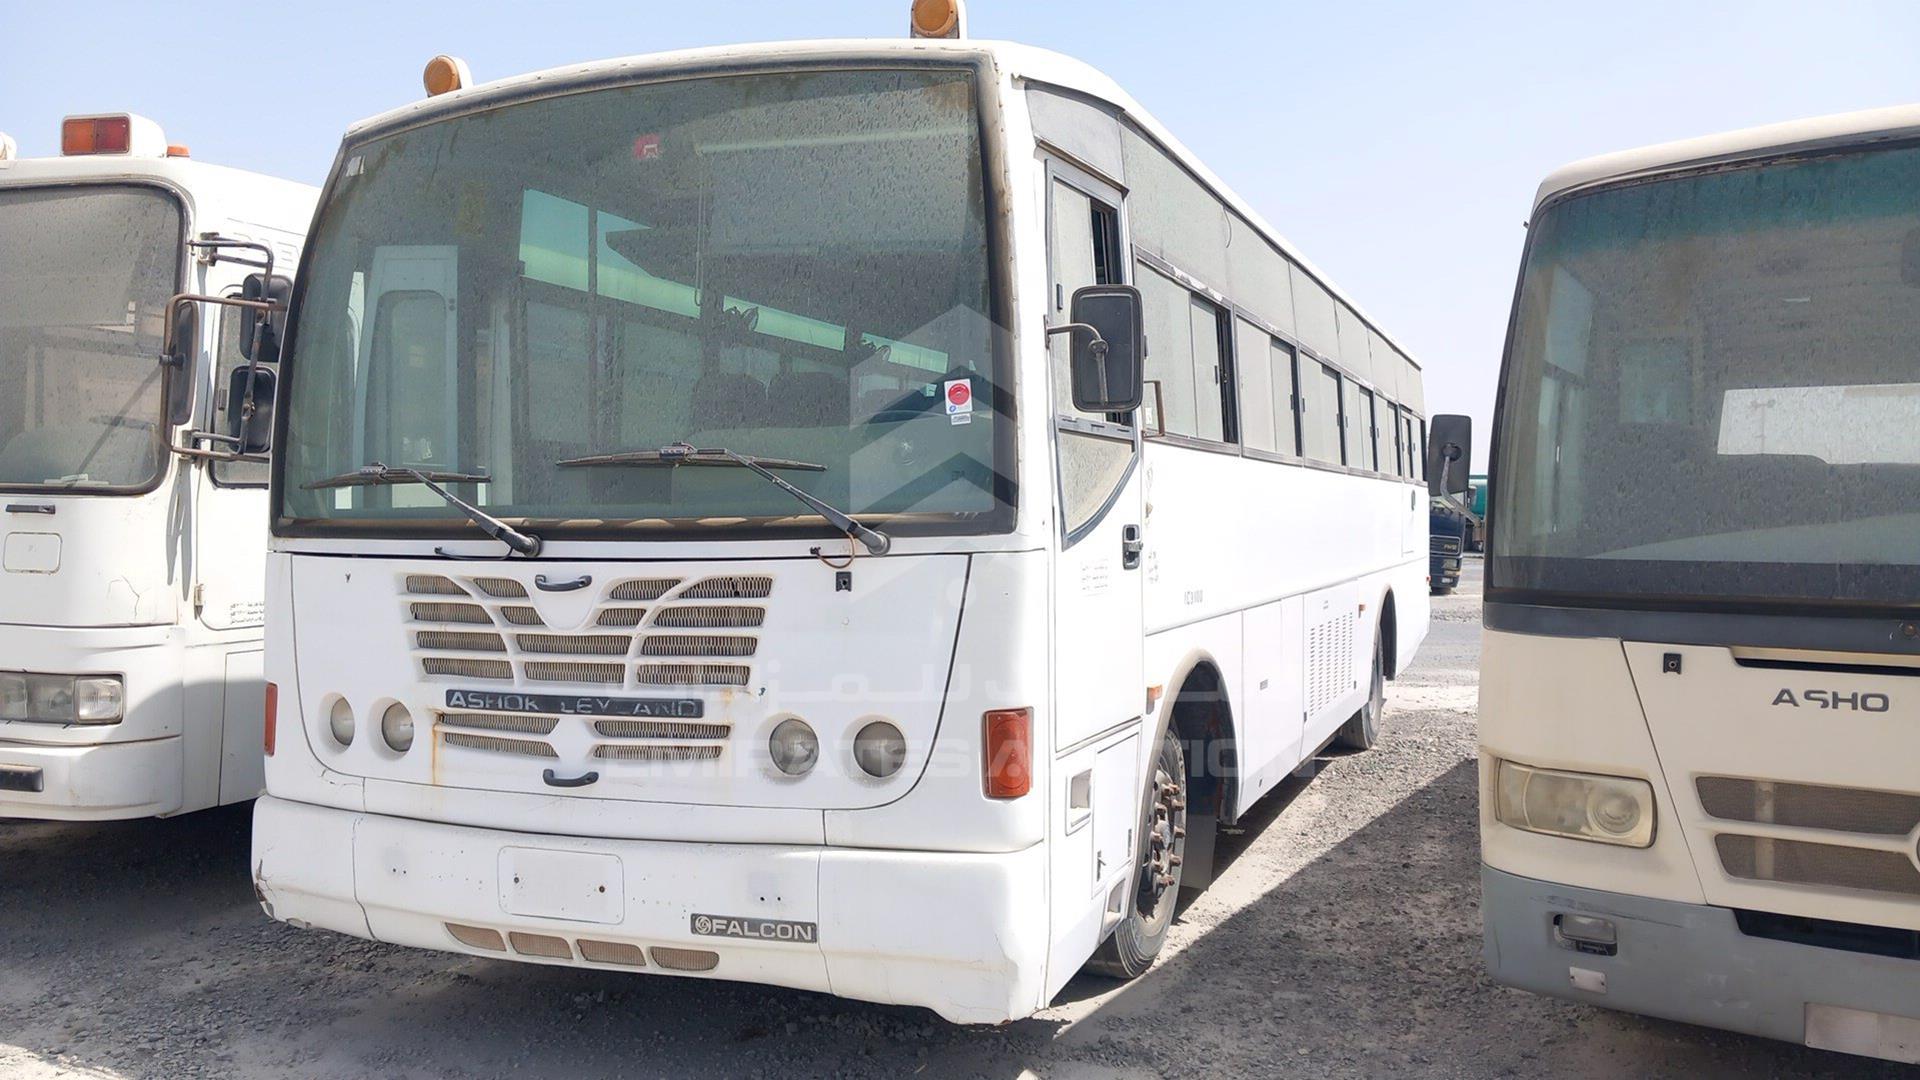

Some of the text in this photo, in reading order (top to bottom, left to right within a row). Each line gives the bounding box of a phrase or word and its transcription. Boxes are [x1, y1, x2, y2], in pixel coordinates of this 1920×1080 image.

[448, 691, 541, 712] ASHOK
[1772, 687, 1890, 713] ASHO
[711, 918, 813, 941] FALCON
